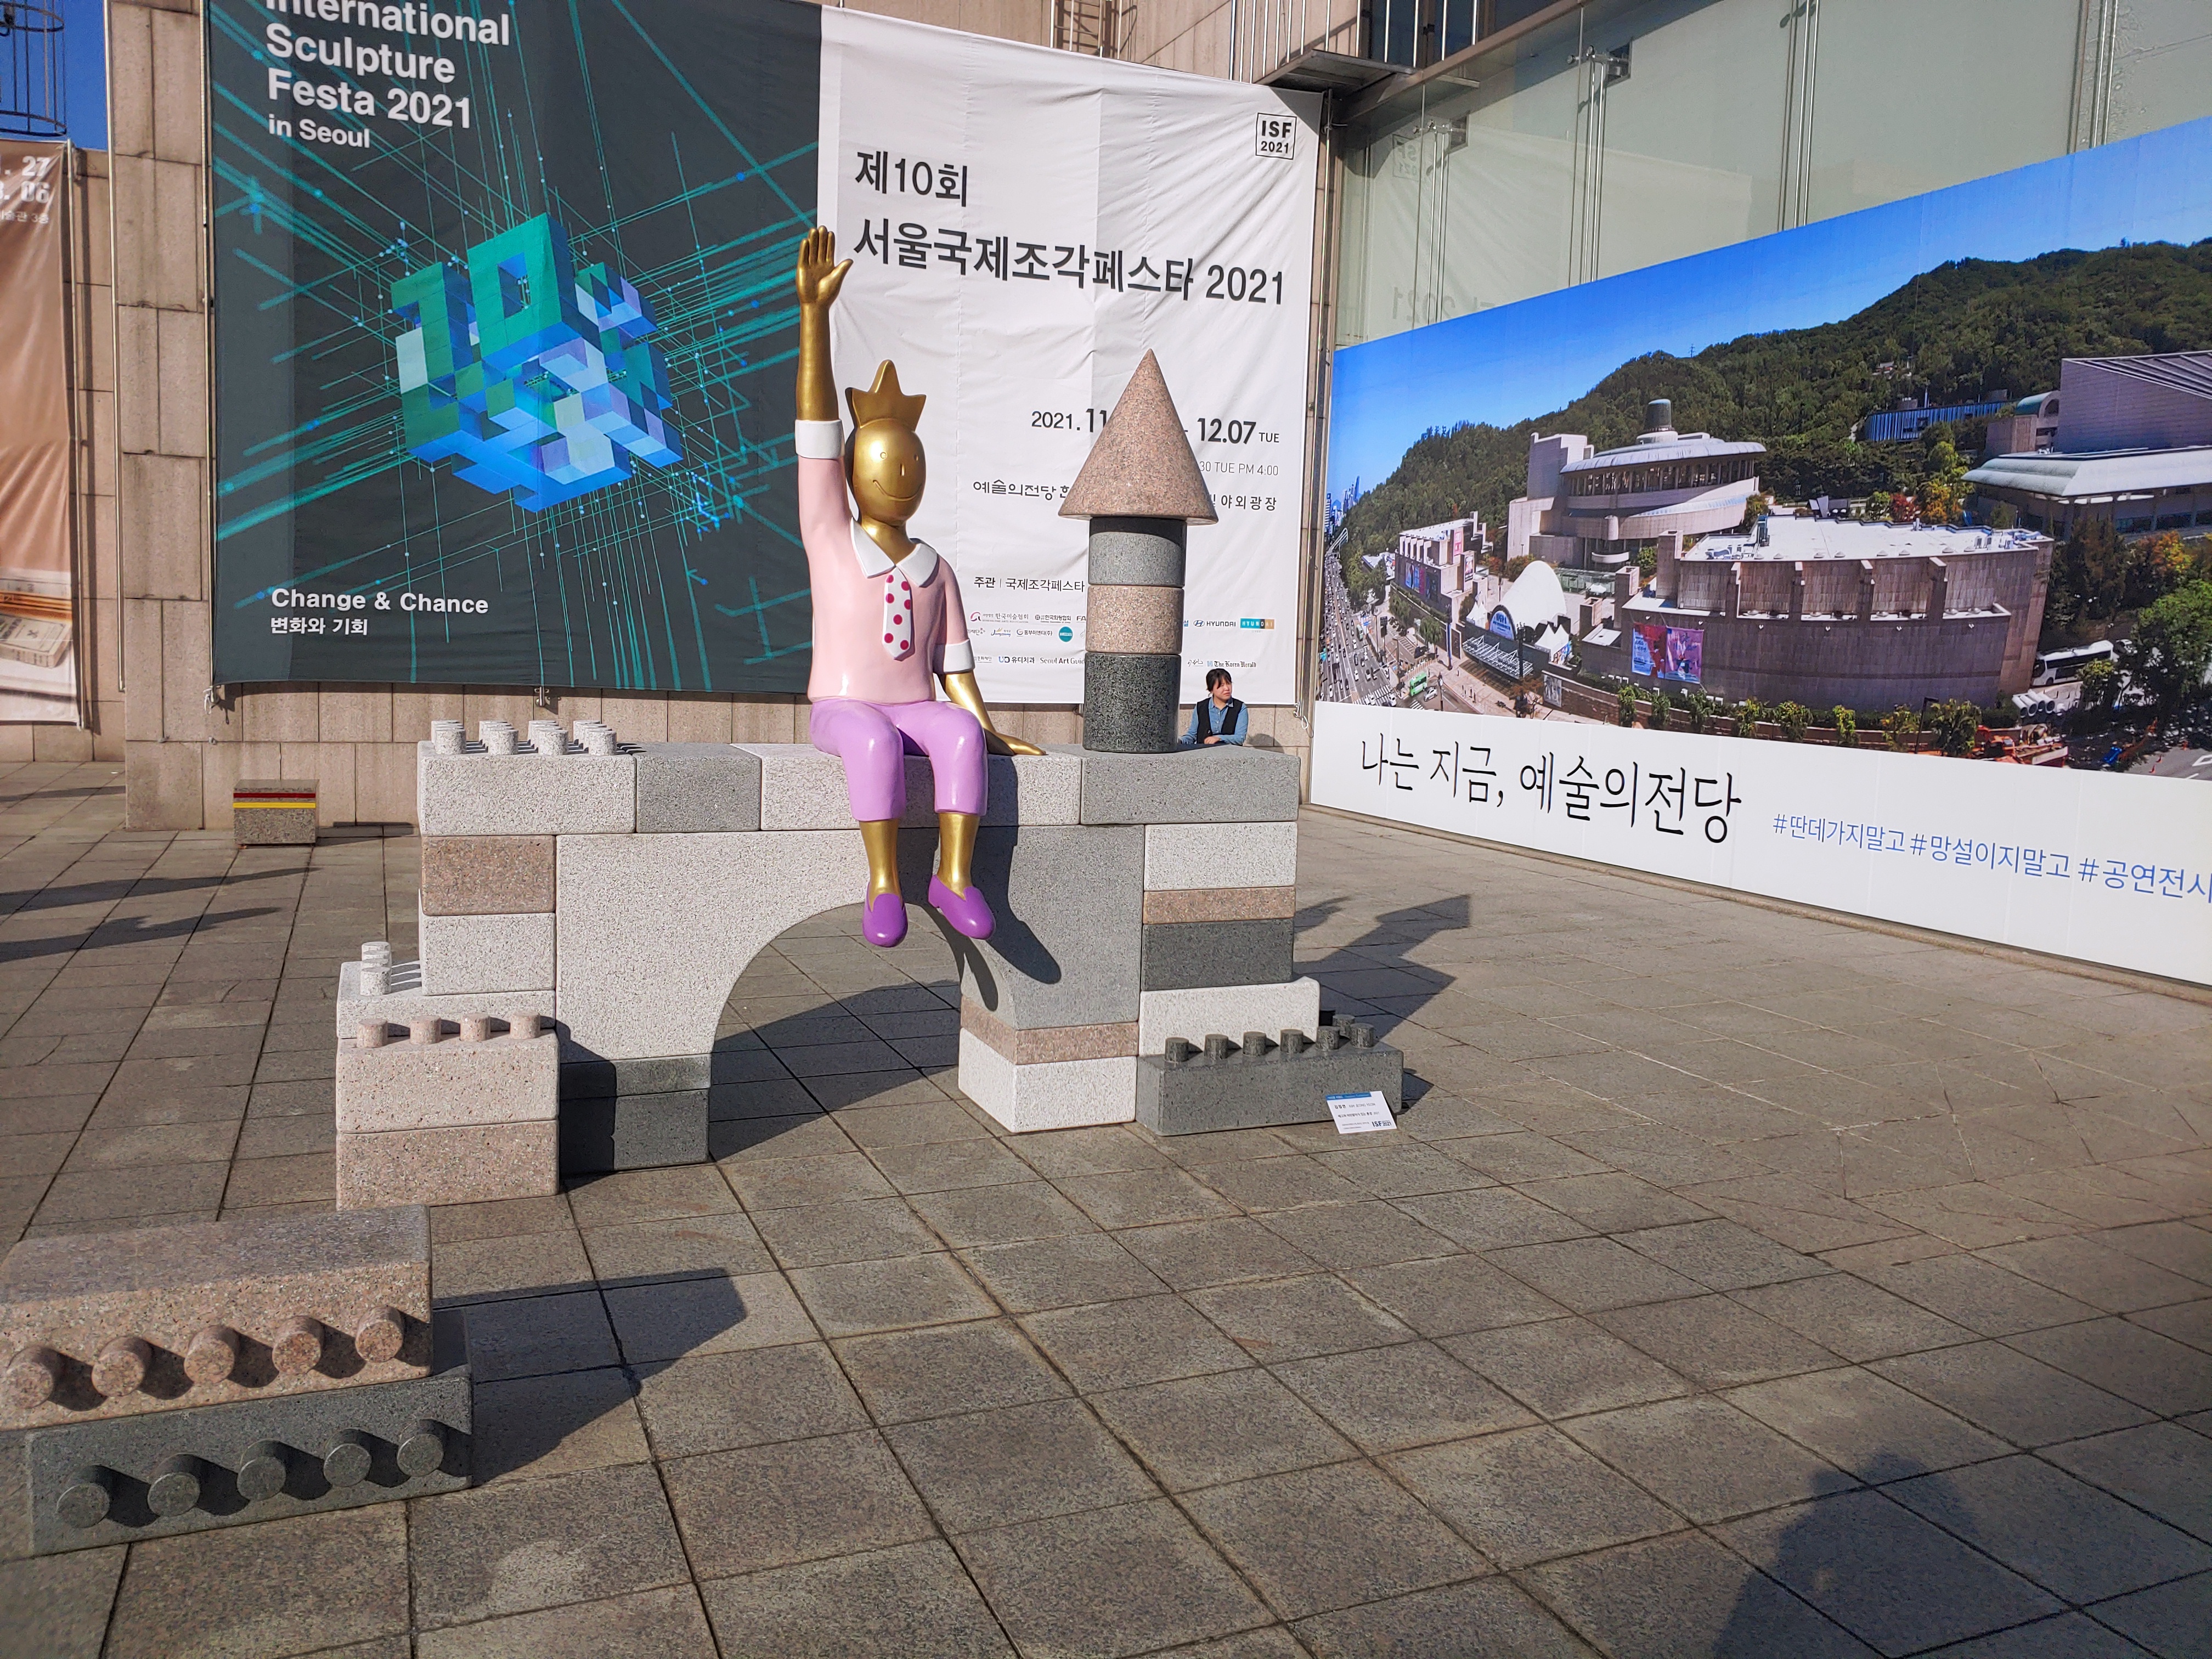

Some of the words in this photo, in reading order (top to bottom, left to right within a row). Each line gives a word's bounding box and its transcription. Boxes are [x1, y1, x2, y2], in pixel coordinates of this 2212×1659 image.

[266, 0, 510, 46] nternational
[266, 22, 455, 83] Sculpture
[268, 67, 376, 116] Festa
[387, 88, 470, 128] 2021
[268, 114, 292, 137] in
[300, 119, 370, 148] Seoul
[1261, 120, 1292, 138] ISF
[1261, 140, 1289, 154] 2021
[22, 156, 50, 177] 27
[855, 150, 968, 207] 제10회
[20, 180, 50, 203] 06
[854, 218, 1194, 301] 서울국제조각페스타
[1206, 265, 1283, 305] 2021
[1197, 417, 1256, 445] 12.07
[1259, 432, 1280, 443] TUE
[1199, 461, 1211, 472] 30
[1215, 462, 1235, 474] TUE
[1238, 464, 1255, 475] PM
[1257, 465, 1278, 476] 4:00
[973, 479, 1057, 500] 예술의전당
[974, 577, 996, 588] 주관
[1005, 578, 1085, 592] 국제조각페스타
[272, 588, 366, 612] Change
[374, 591, 391, 611] &
[400, 592, 489, 614] Chance
[270, 617, 326, 634] 변화와
[332, 618, 368, 635] 기회
[1361, 732, 1419, 791] 나는
[1430, 741, 1504, 807] 지금,
[1519, 751, 1742, 843] 예술의전당
[1773, 813, 1905, 853] #딴데가지말고
[1909, 832, 2070, 879] #망설이지말고
